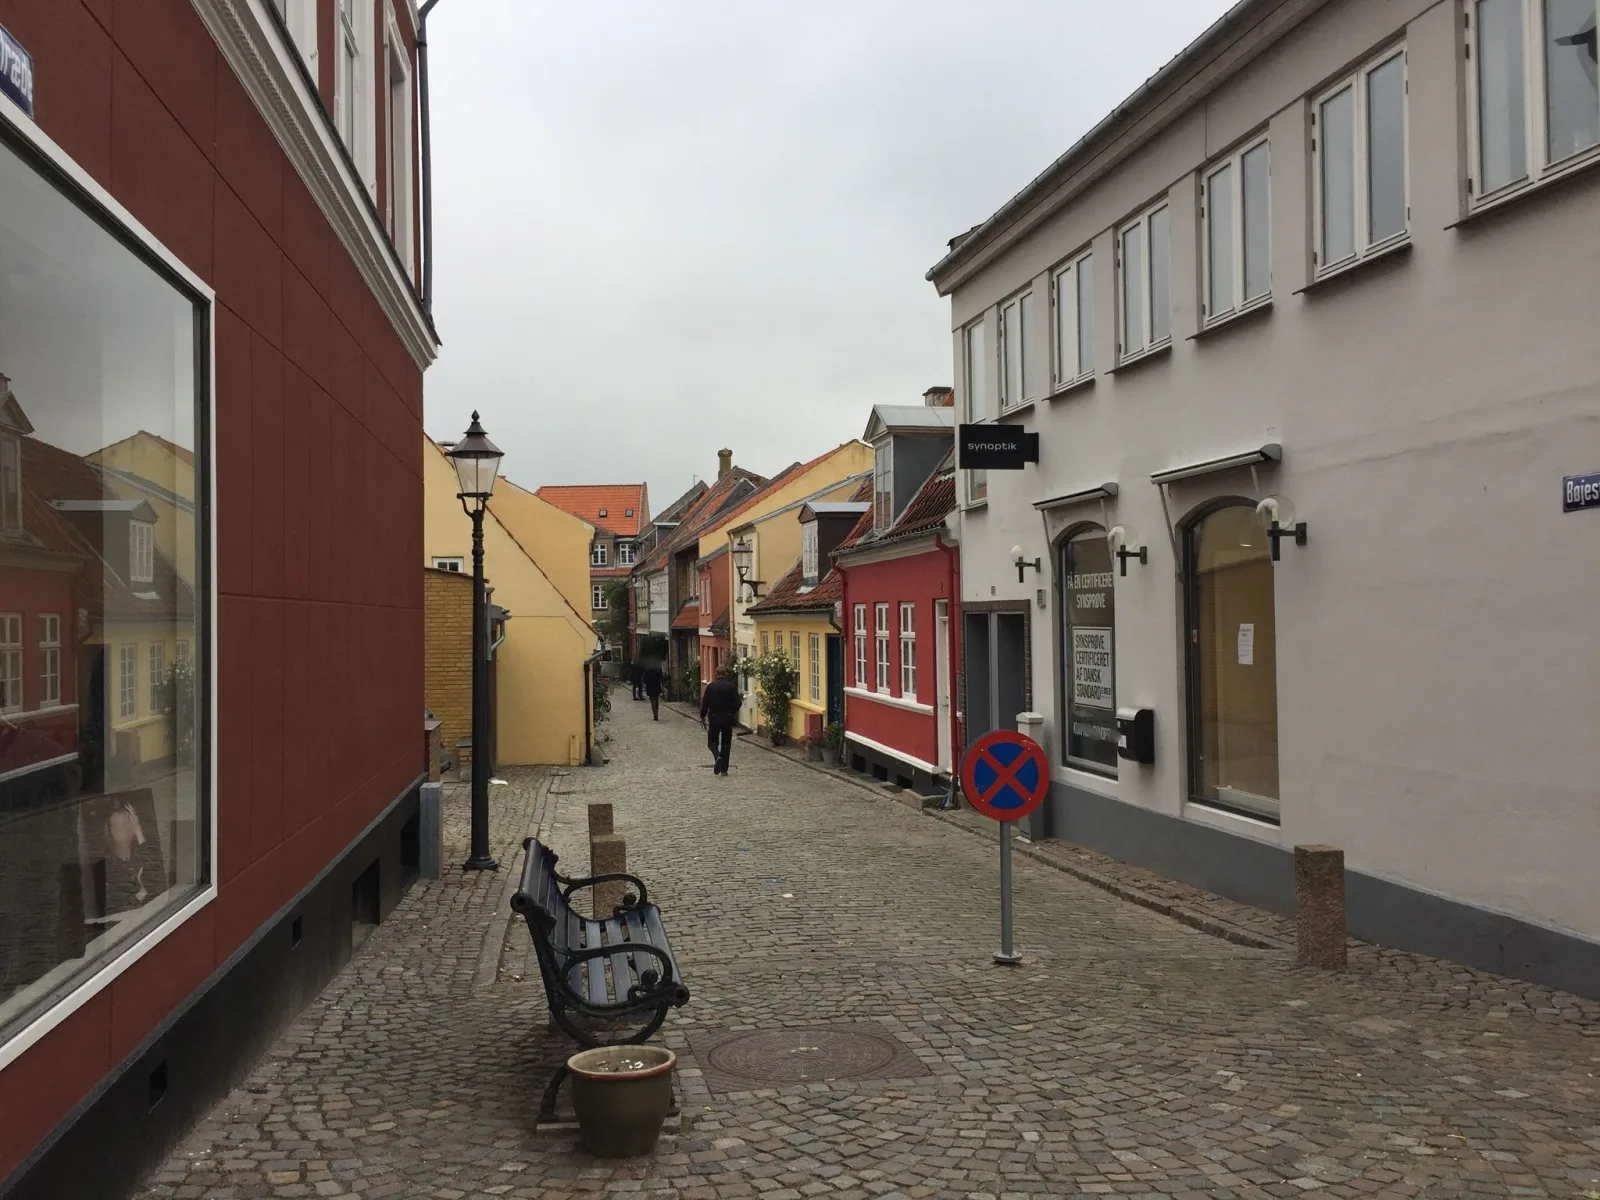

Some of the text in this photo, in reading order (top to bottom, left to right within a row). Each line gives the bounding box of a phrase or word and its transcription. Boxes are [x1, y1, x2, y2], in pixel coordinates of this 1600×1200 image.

[967, 442, 1017, 451] synoptik
[1567, 479, 1600, 505] Bøjes
[1074, 574, 1081, 589] EN
[1076, 593, 1106, 609] SYNSPRØVE
[1076, 634, 1105, 649] SYNSPRØVE
[1076, 650, 1110, 667] CERTIFICERET
[1076, 667, 1102, 683] AF DANSK
[1076, 683, 1101, 700] STANDARD
